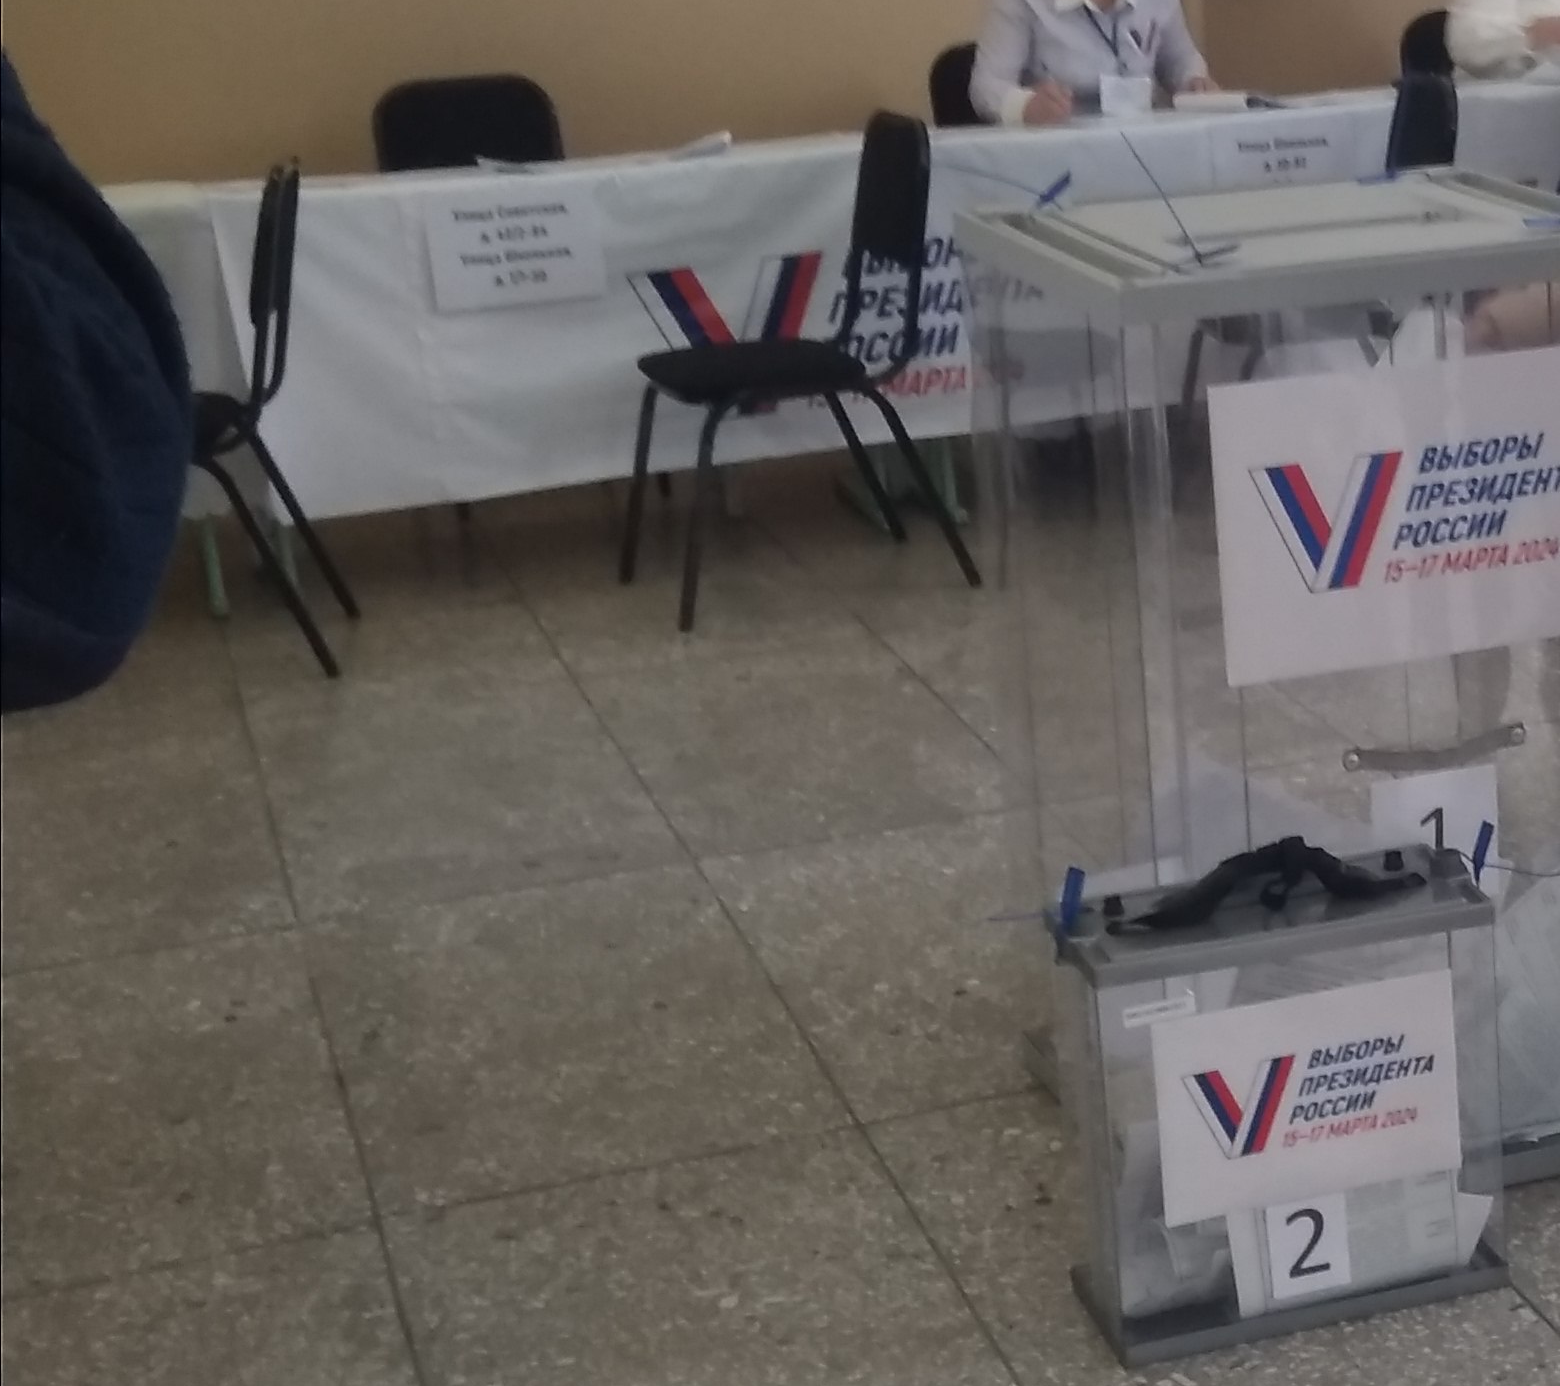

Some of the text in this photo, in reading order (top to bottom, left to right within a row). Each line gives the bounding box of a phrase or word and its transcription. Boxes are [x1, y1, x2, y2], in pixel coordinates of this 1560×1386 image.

[1418, 431, 1545, 475] ВЫБОРЫ
[1392, 509, 1508, 551] РОССИИ
[1441, 544, 1509, 575] МАРТА
[1512, 536, 1560, 565] 2024
[1420, 806, 1444, 851] 1
[1306, 1033, 1405, 1070] ВЫБОРЫ
[1298, 1054, 1435, 1097] ПРЕЗИДЕНТА
[1289, 1089, 1377, 1126] РОССИИ
[1326, 1114, 1378, 1139] МАРТА
[1381, 1106, 1418, 1129] 2024
[1286, 1208, 1331, 1279] 2
